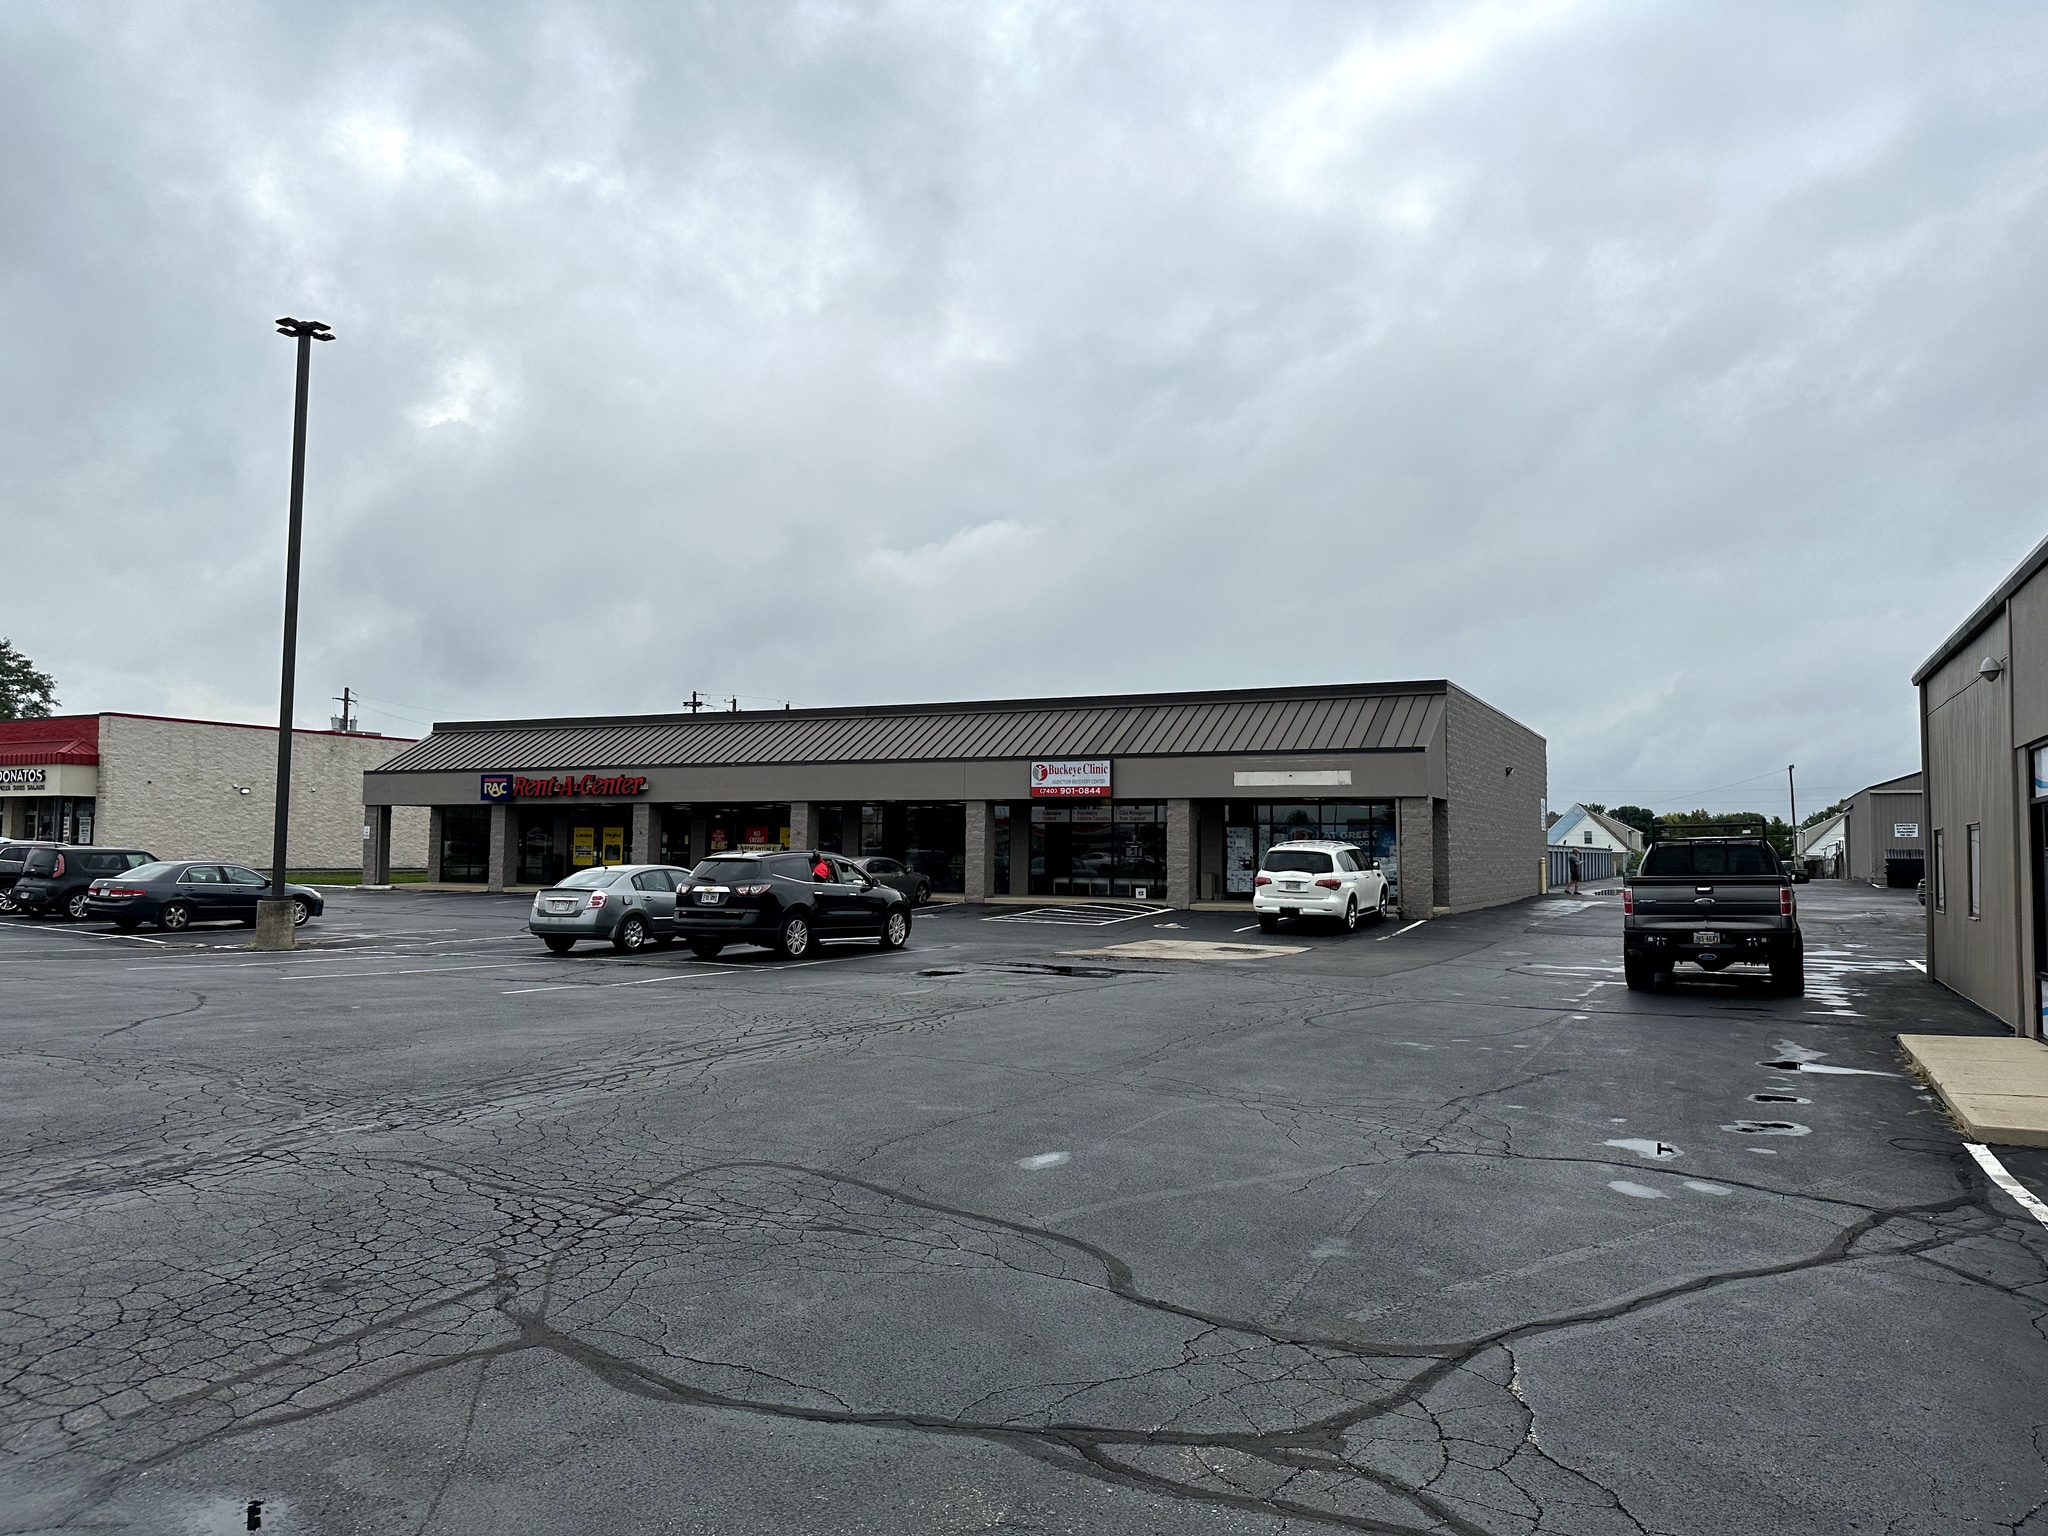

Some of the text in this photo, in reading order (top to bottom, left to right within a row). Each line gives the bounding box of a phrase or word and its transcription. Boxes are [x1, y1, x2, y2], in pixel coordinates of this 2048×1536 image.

[1048, 763, 1108, 777] Buckeye Clinic
[484, 782, 507, 797] RAC
[1060, 787, 1101, 795] 901-0844
[1339, 829, 1378, 839] GREEK
